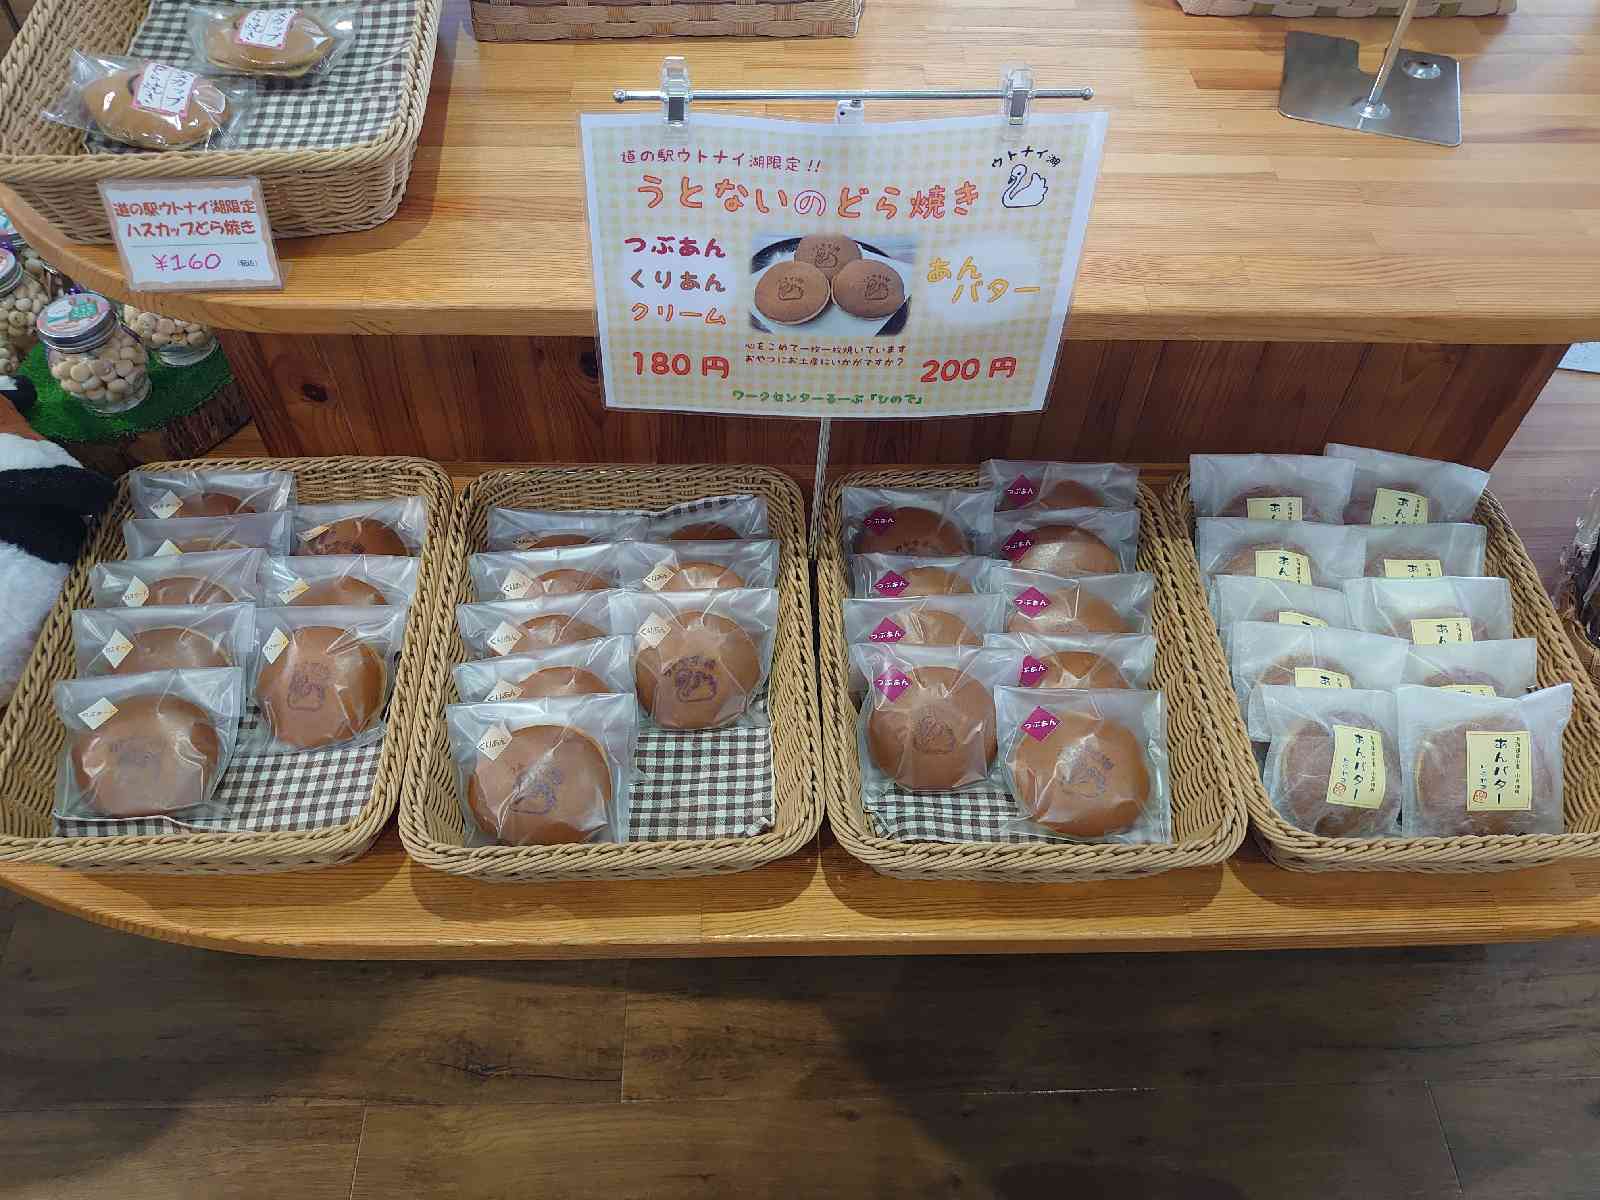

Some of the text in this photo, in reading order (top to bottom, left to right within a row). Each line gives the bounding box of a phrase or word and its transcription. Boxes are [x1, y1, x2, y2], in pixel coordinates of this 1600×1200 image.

[638, 174, 980, 219] うとないのどら焼き
[112, 199, 257, 218] 道の駅ウトナイ湖限定
[624, 236, 727, 258] つぶあん
[152, 252, 222, 271] ¥160
[926, 255, 983, 283] あん
[630, 268, 727, 292] くりあん
[951, 278, 1042, 305] バター
[631, 302, 727, 325] クリーム
[1007, 487, 1034, 496] つぶあん
[1015, 598, 1049, 608] つぶあん
[877, 678, 910, 688] つぶあん
[1022, 719, 1057, 730] つぶあん
[1353, 731, 1367, 801] あんバター
[1494, 737, 1509, 805] あんバター
